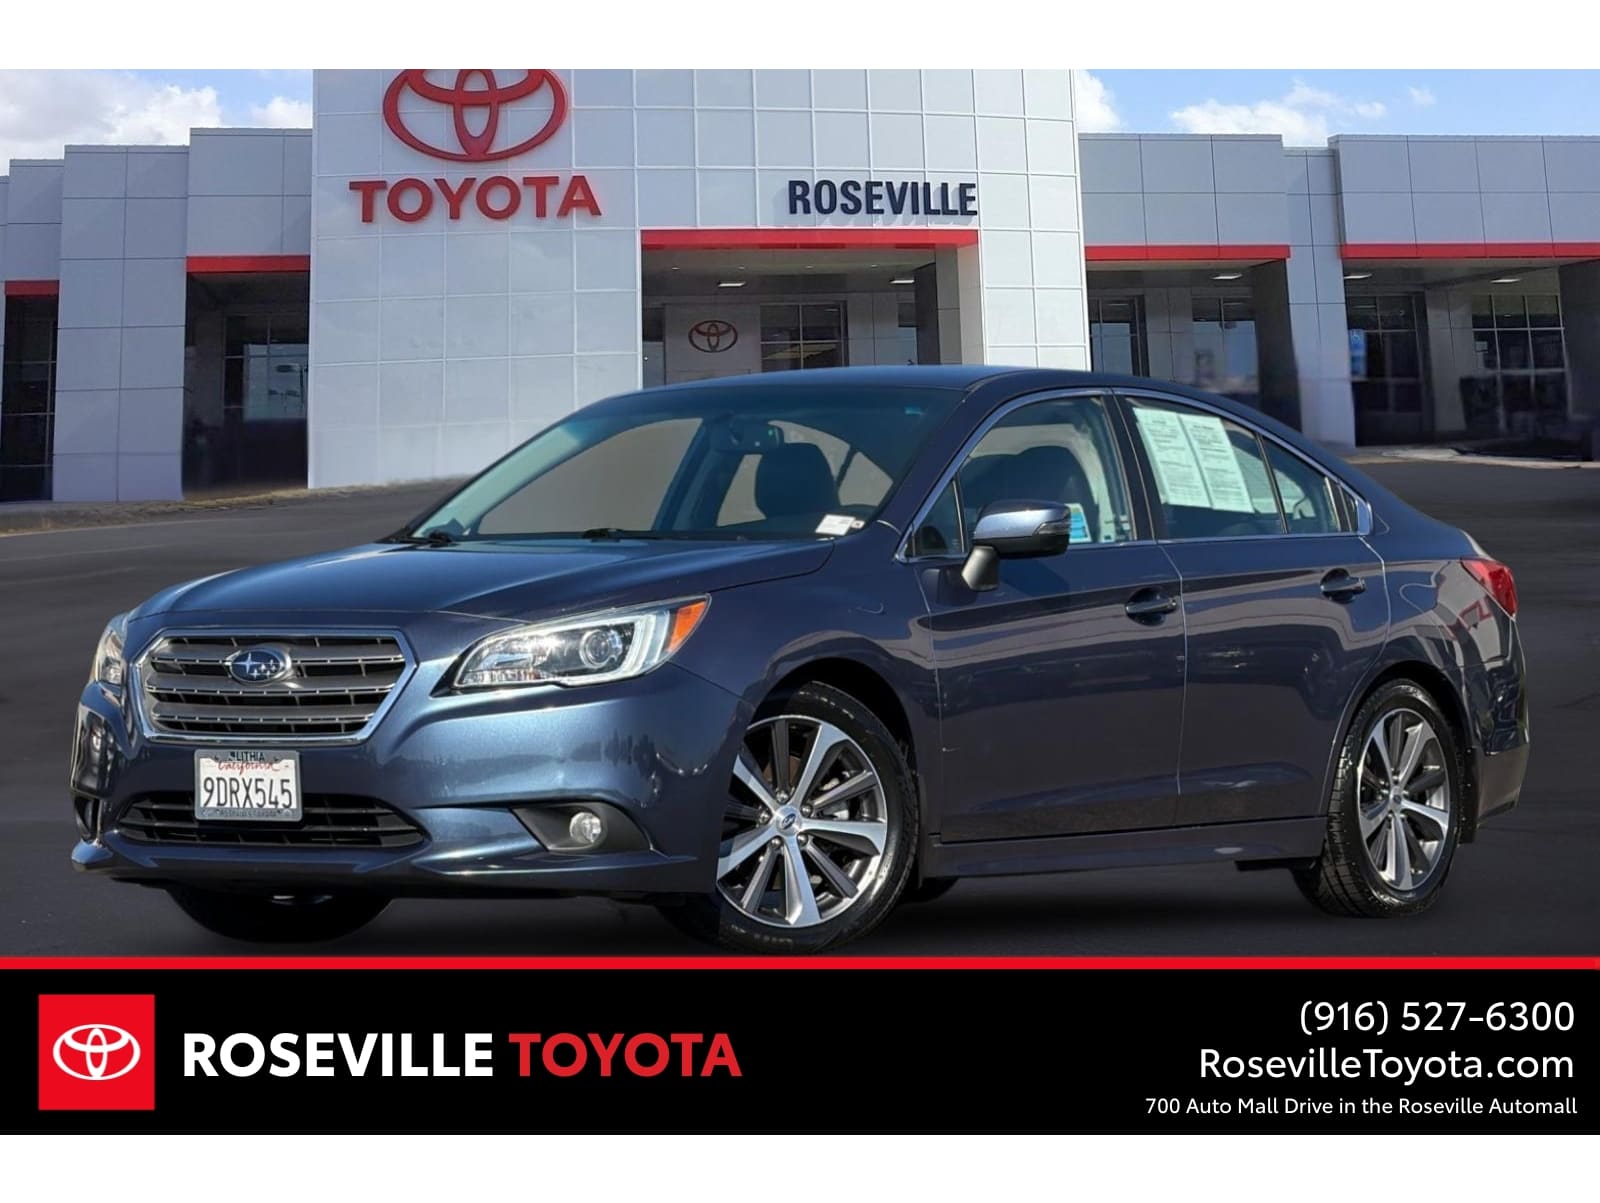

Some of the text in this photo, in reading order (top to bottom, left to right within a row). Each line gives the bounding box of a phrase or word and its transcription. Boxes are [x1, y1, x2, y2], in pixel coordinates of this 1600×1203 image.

[349, 175, 602, 223] TOYOTA
[788, 180, 978, 216] ROSEVILLE
[236, 751, 265, 762] LITHIA
[203, 777, 293, 809] 9DRX545
